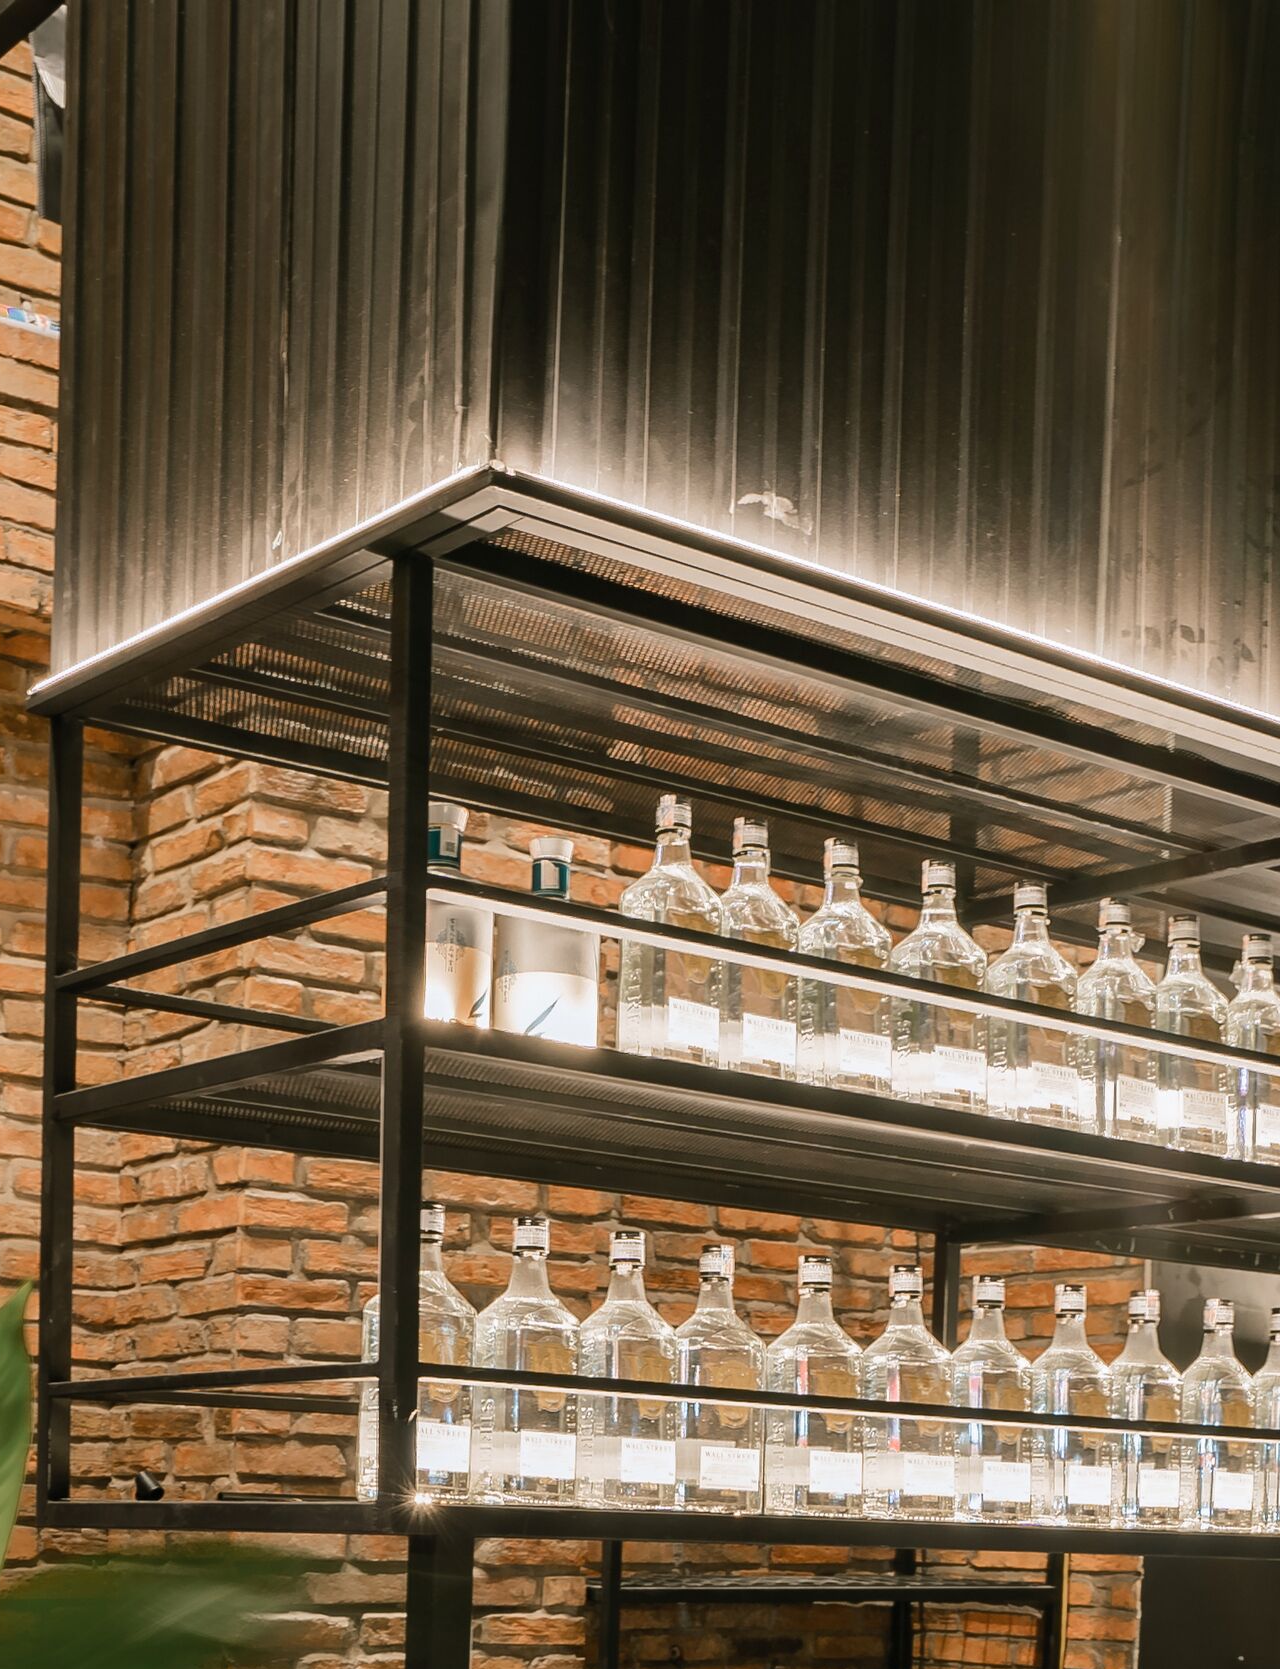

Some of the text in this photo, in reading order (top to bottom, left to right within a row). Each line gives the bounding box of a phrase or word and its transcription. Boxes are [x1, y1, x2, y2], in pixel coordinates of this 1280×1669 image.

[842, 1033, 888, 1048] WALL STREET
[938, 1050, 983, 1064] WALL STREET
[417, 1425, 436, 1436] ALL
[625, 1442, 672, 1452] WALL STREET
[705, 1450, 756, 1461] WALL STREET
